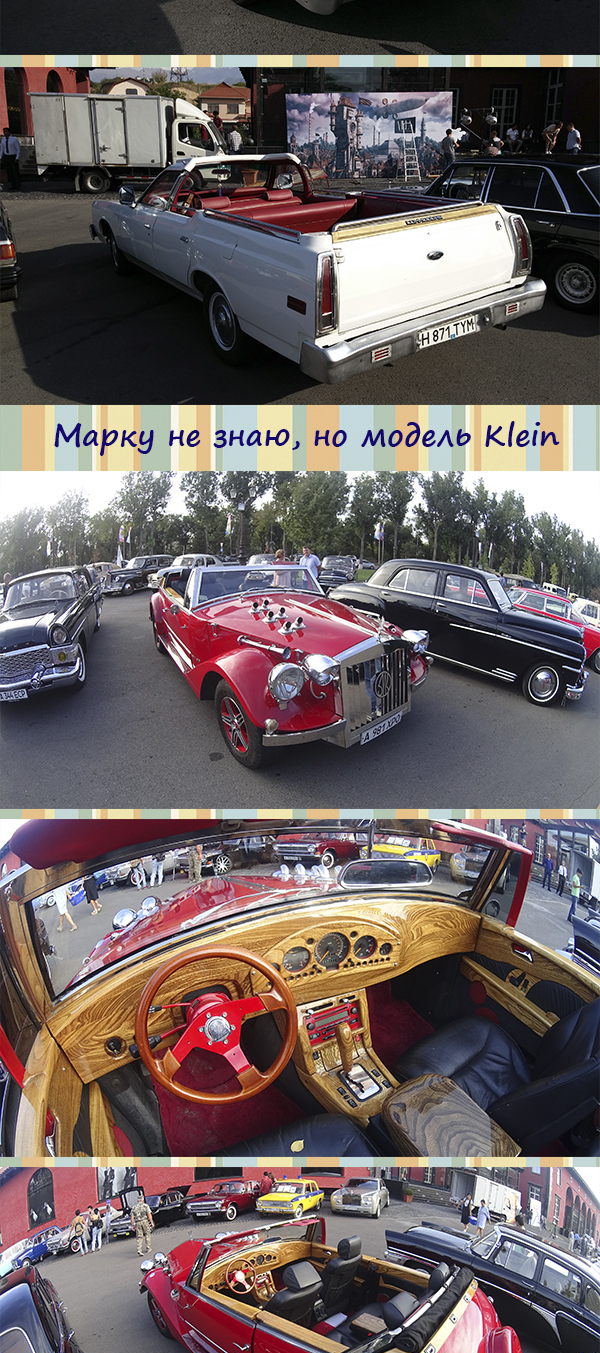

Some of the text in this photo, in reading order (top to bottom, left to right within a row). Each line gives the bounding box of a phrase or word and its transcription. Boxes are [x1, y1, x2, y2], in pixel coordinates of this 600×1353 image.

[421, 318, 475, 346] H 871 TYM
